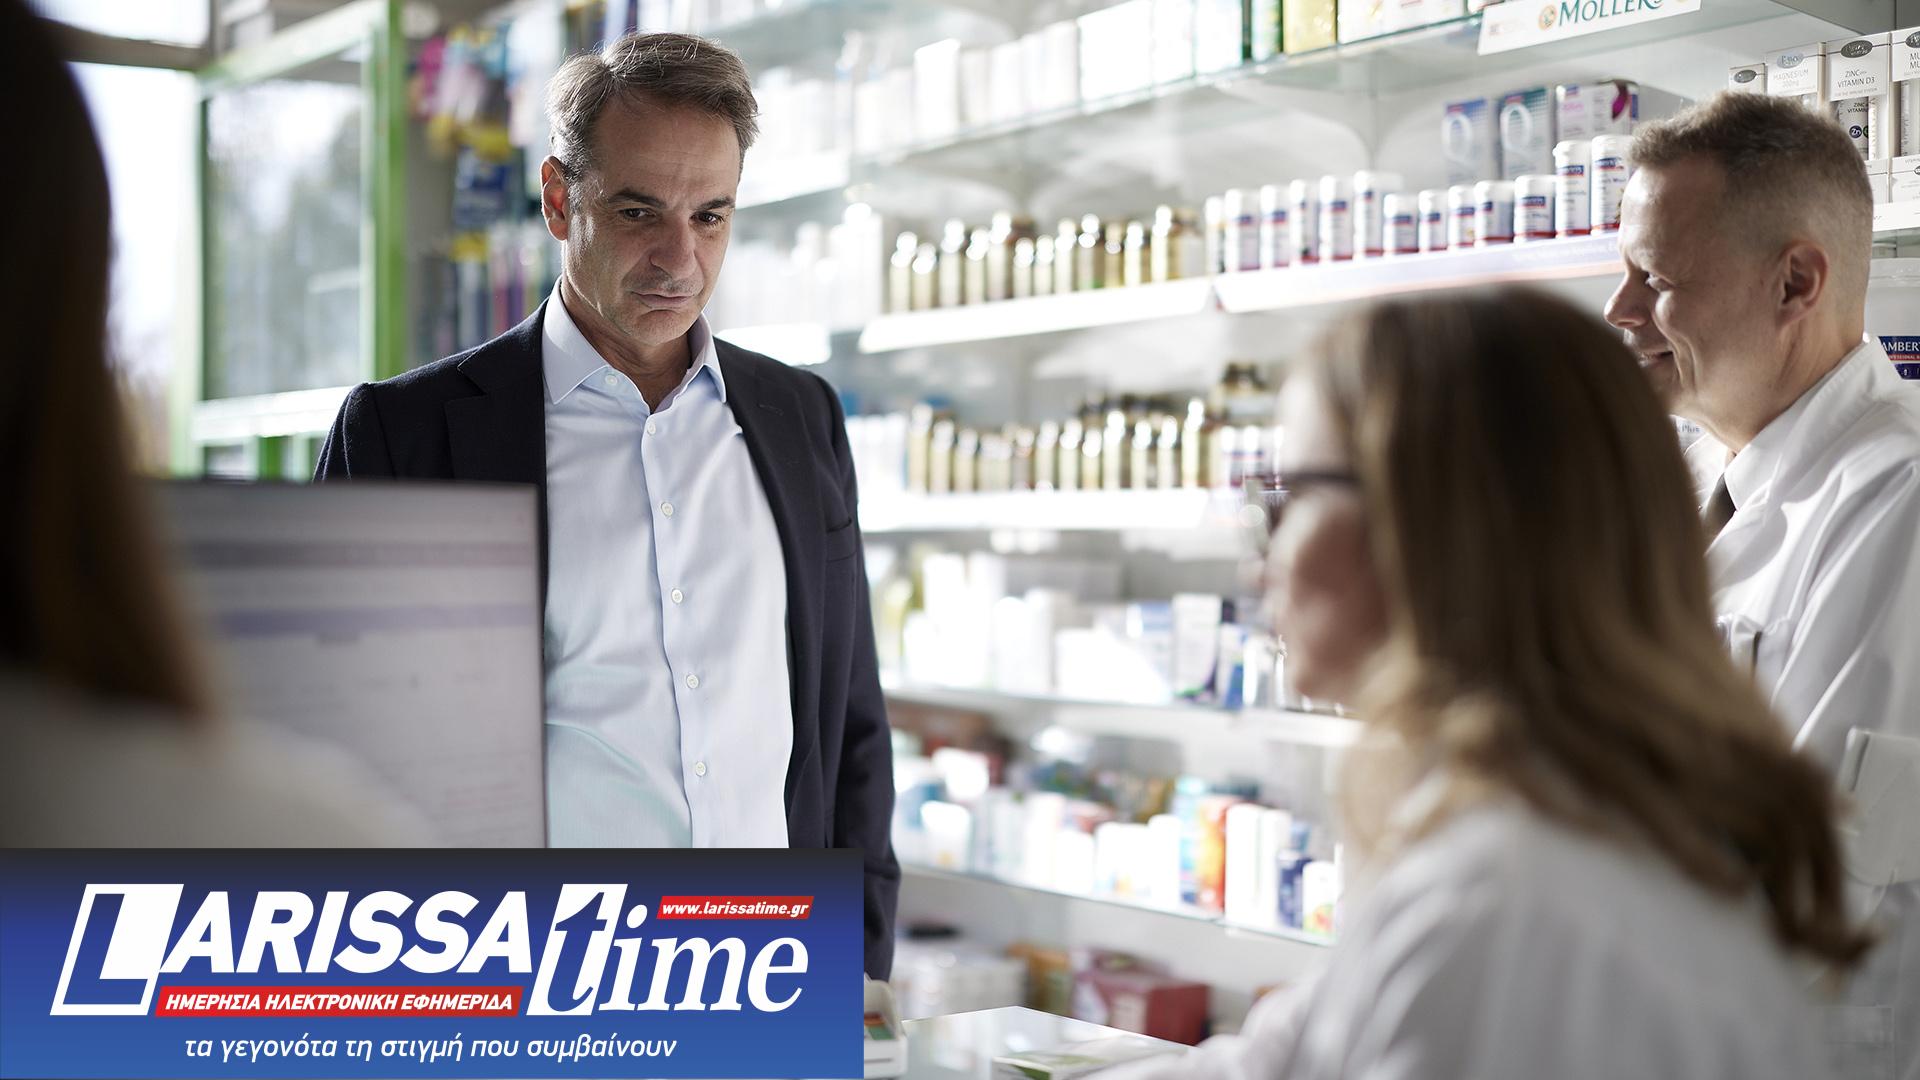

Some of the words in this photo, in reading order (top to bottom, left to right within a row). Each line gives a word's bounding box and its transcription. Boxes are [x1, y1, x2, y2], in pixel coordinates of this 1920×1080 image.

[1844, 70, 1860, 78] ZINC
[1837, 78, 1864, 88] VITAMIN
[1865, 77, 1875, 85] D3
[1851, 128, 1861, 136] Zn
